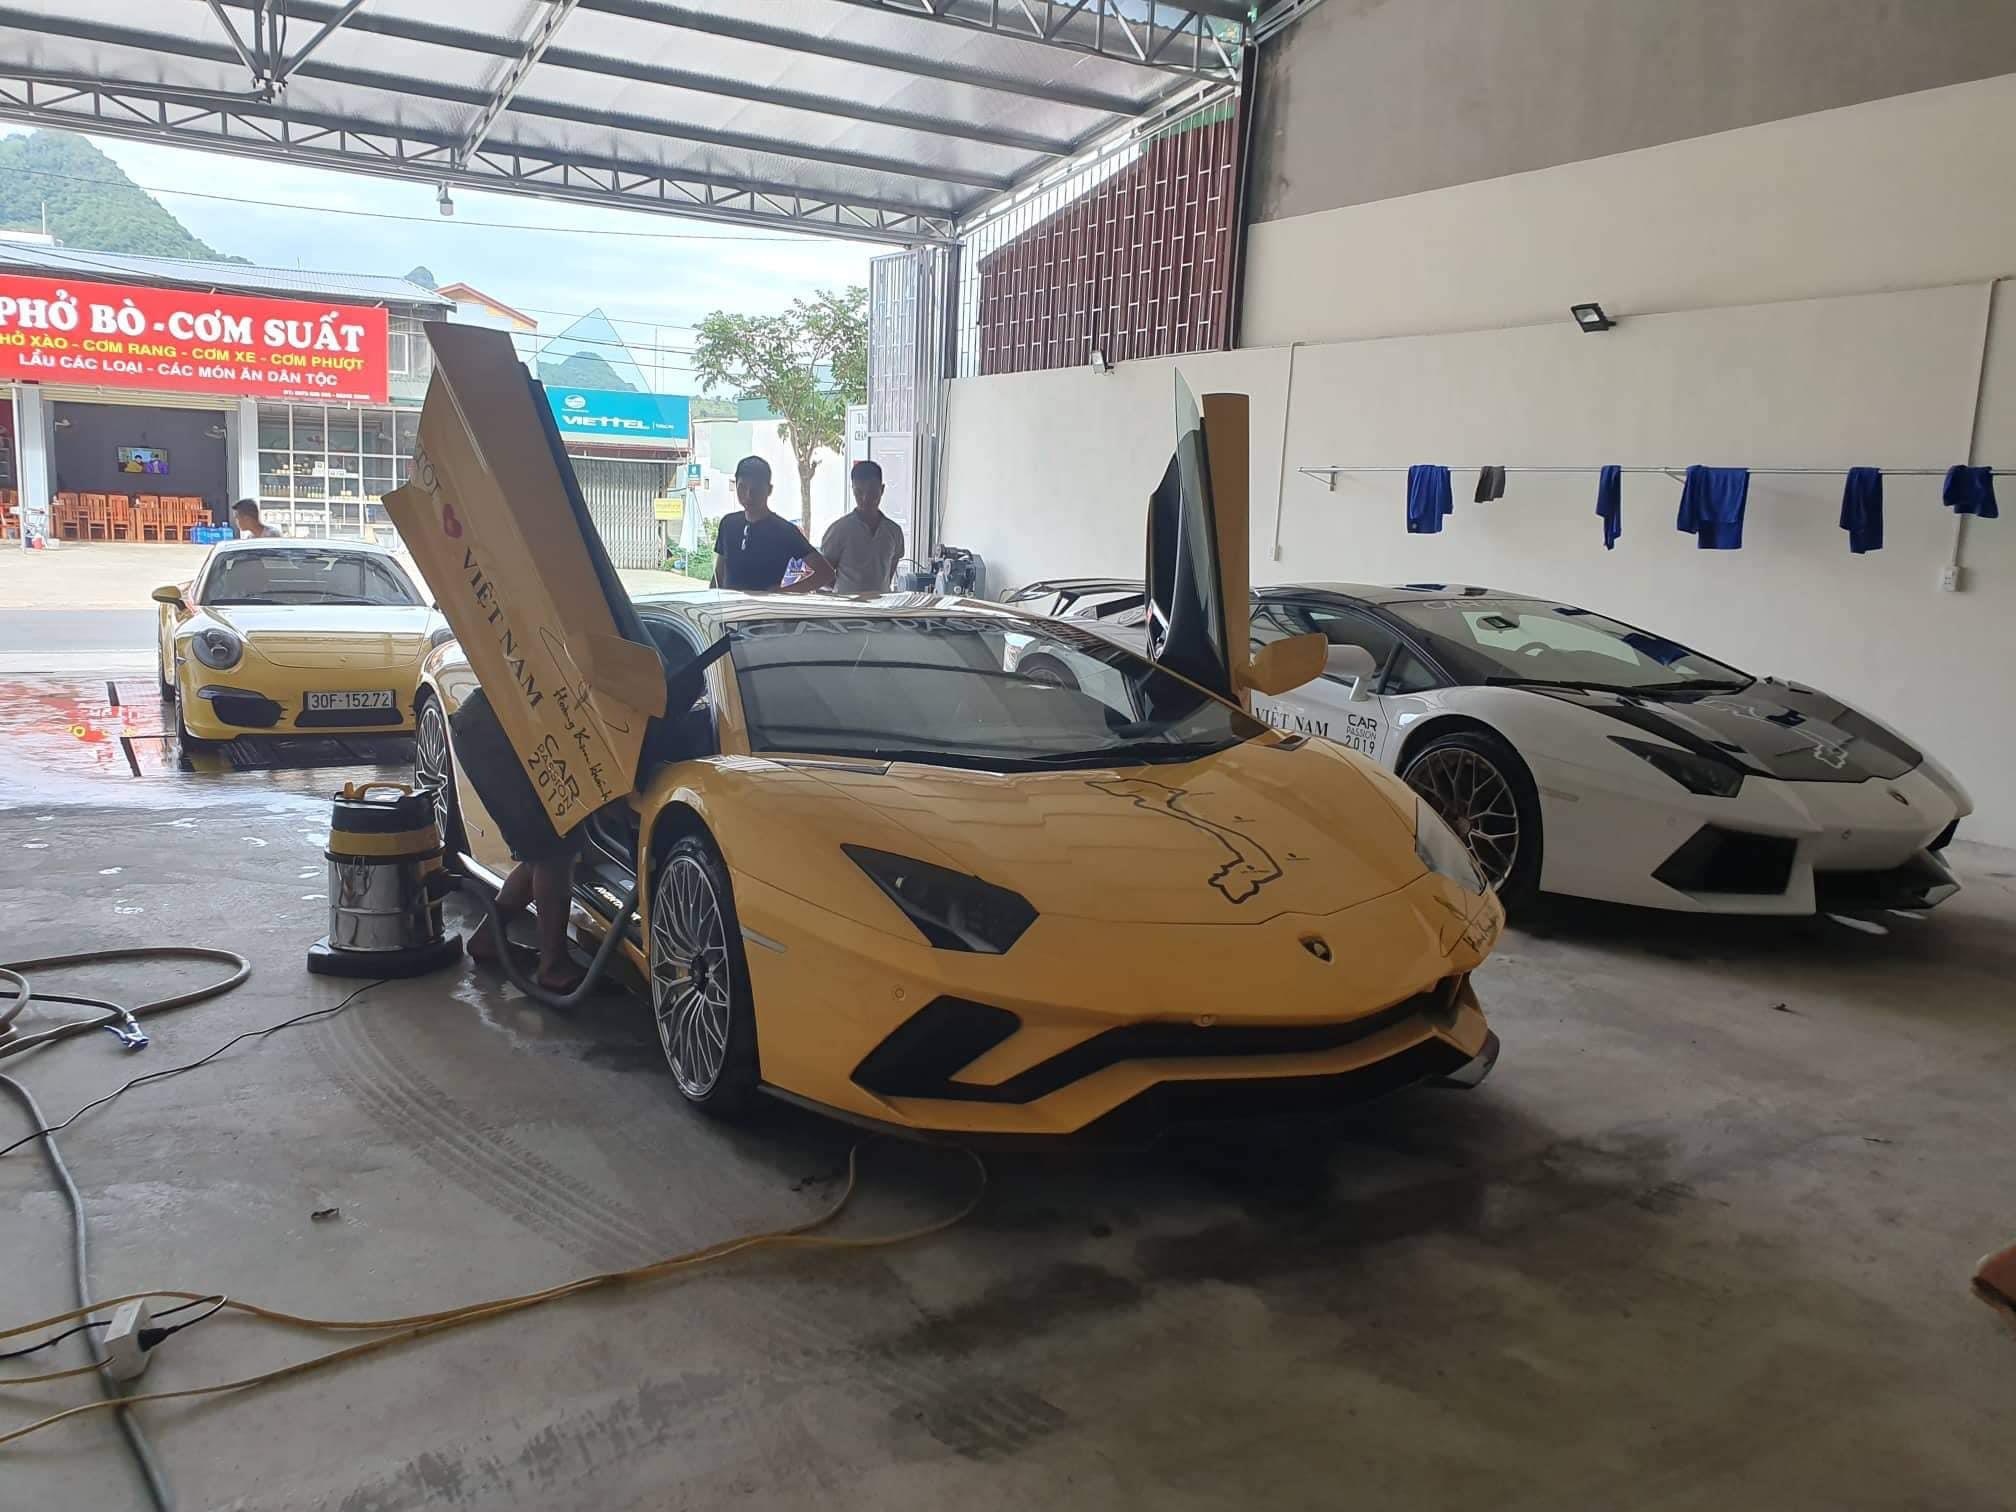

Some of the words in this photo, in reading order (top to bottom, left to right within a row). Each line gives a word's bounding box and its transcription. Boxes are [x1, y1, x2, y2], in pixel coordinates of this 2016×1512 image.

[0, 288, 79, 331] PHỞ
[89, 298, 146, 337] BÒ
[168, 308, 254, 345] CƠM
[263, 310, 365, 353] SUẤT
[0, 329, 26, 346] HỞ
[31, 333, 68, 350] XÀO
[83, 339, 123, 354] CƠM
[128, 343, 177, 359] RANG
[192, 348, 230, 362] CƠM
[235, 351, 257, 364] XE
[271, 353, 307, 368] CƠM
[311, 356, 365, 372] PHƯỢT
[60, 355, 98, 370] CÁC
[103, 359, 143, 375] LOẠI
[158, 361, 193, 377] CÁC
[198, 366, 236, 380] MÓN
[267, 369, 302, 384] DÂN
[305, 371, 338, 387] TỘC
[498, 627, 545, 709] NAM
[1295, 714, 1329, 737] NAM
[1346, 726, 1377, 740] PASSION
[1347, 713, 1378, 732] CAR
[1345, 735, 1376, 755] 2019
[527, 751, 566, 817] 2019
[544, 734, 580, 802] CAR
